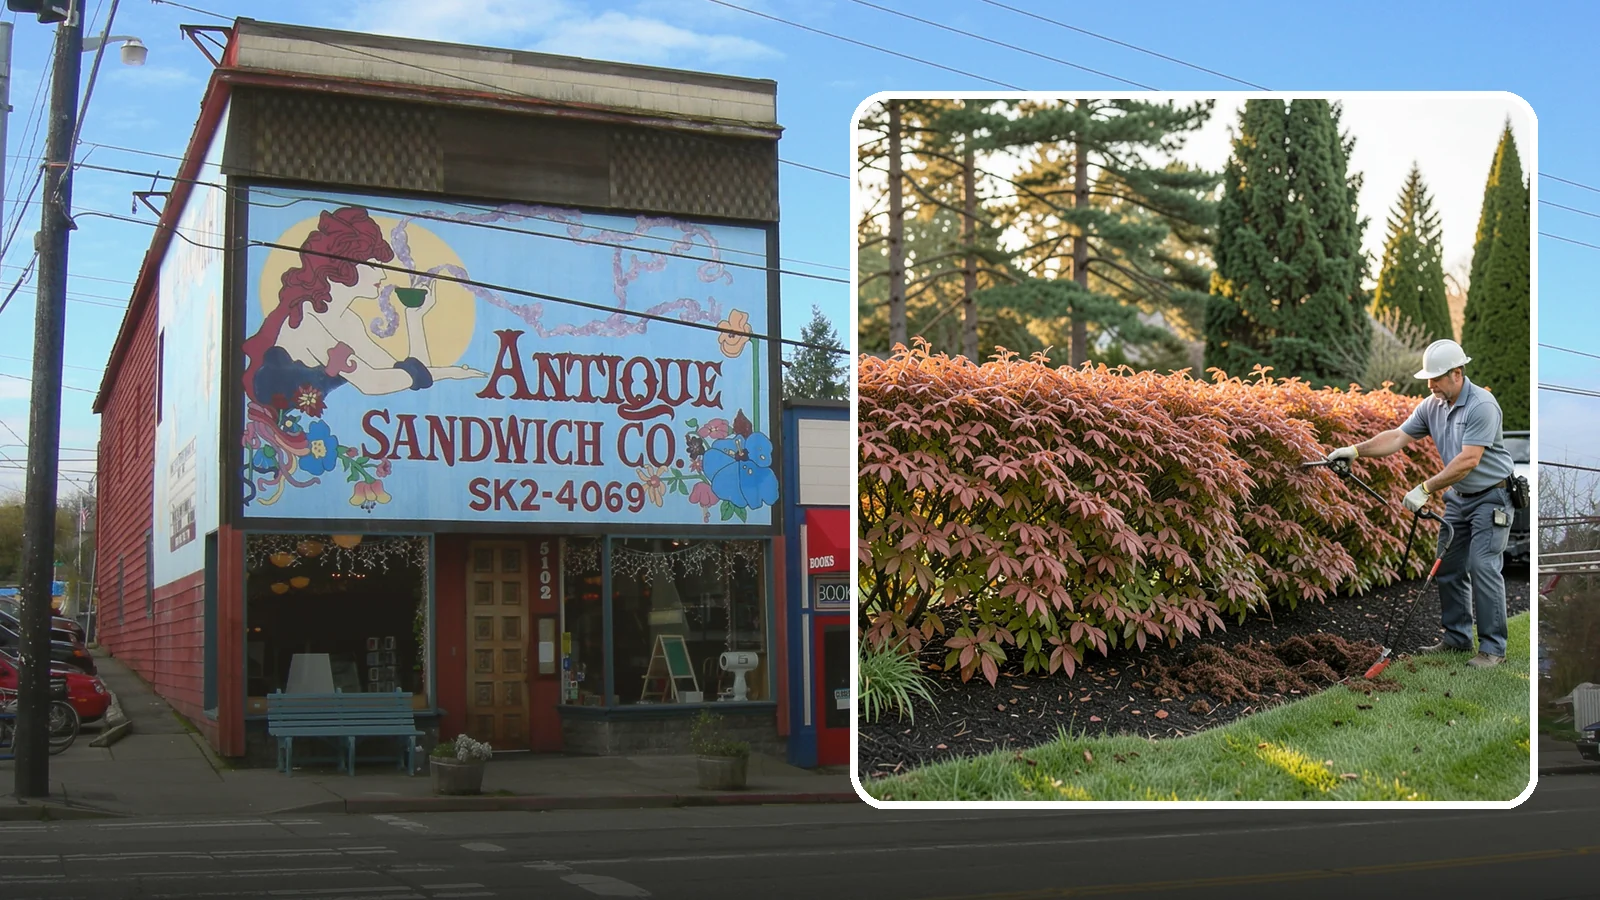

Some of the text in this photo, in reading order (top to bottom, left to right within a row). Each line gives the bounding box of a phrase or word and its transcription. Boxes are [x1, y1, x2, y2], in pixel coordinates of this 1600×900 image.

[476, 328, 722, 421] ANTIQUE
[361, 409, 685, 469] SANDWICH CO.
[469, 478, 646, 513] SK2-4069
[540, 541, 551, 599] 5102
[809, 556, 835, 569] BOOKS
